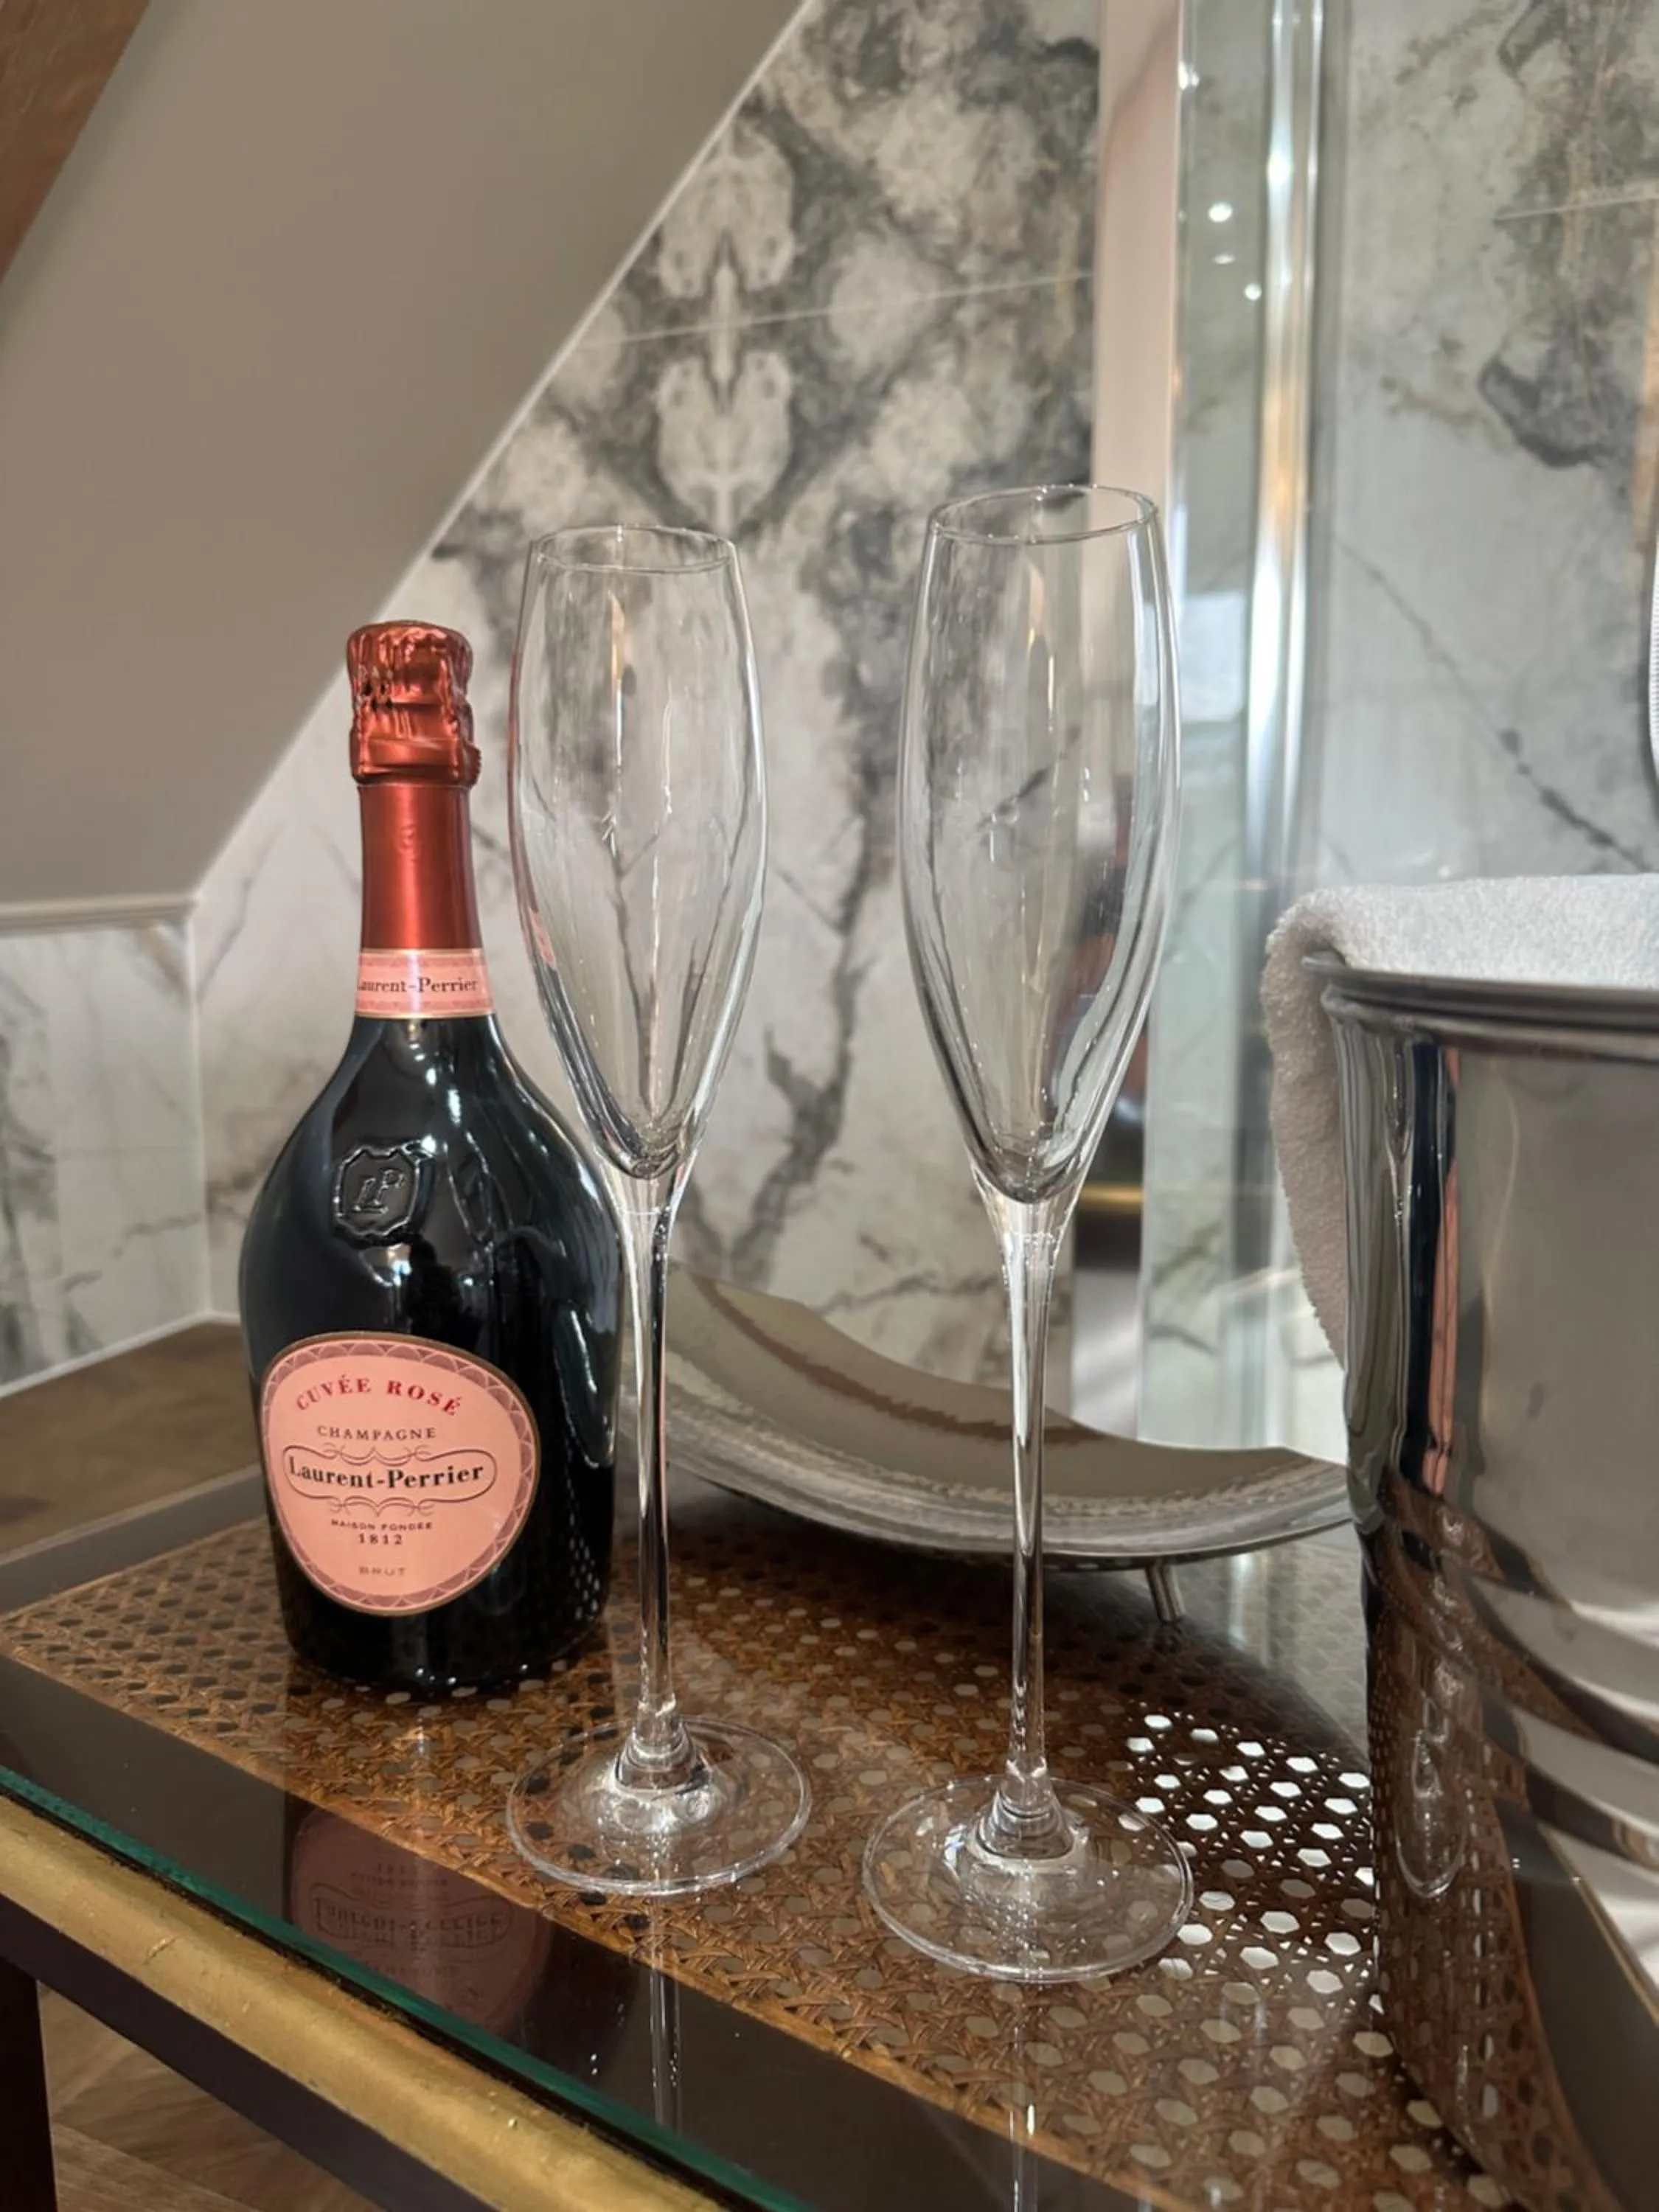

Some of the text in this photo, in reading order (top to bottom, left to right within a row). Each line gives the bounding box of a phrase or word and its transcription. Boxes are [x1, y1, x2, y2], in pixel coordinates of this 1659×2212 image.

[357, 975, 479, 993] aurent-Perrier
[296, 1374, 463, 1416] CUVÉE ROSÉ
[317, 1425, 437, 1441] CHAMPAGNE
[288, 1455, 484, 1489] Laurent-Perrier
[331, 1518, 376, 1531] MAISON
[358, 1533, 403, 1545] 1812
[358, 1565, 406, 1576] BRUT
